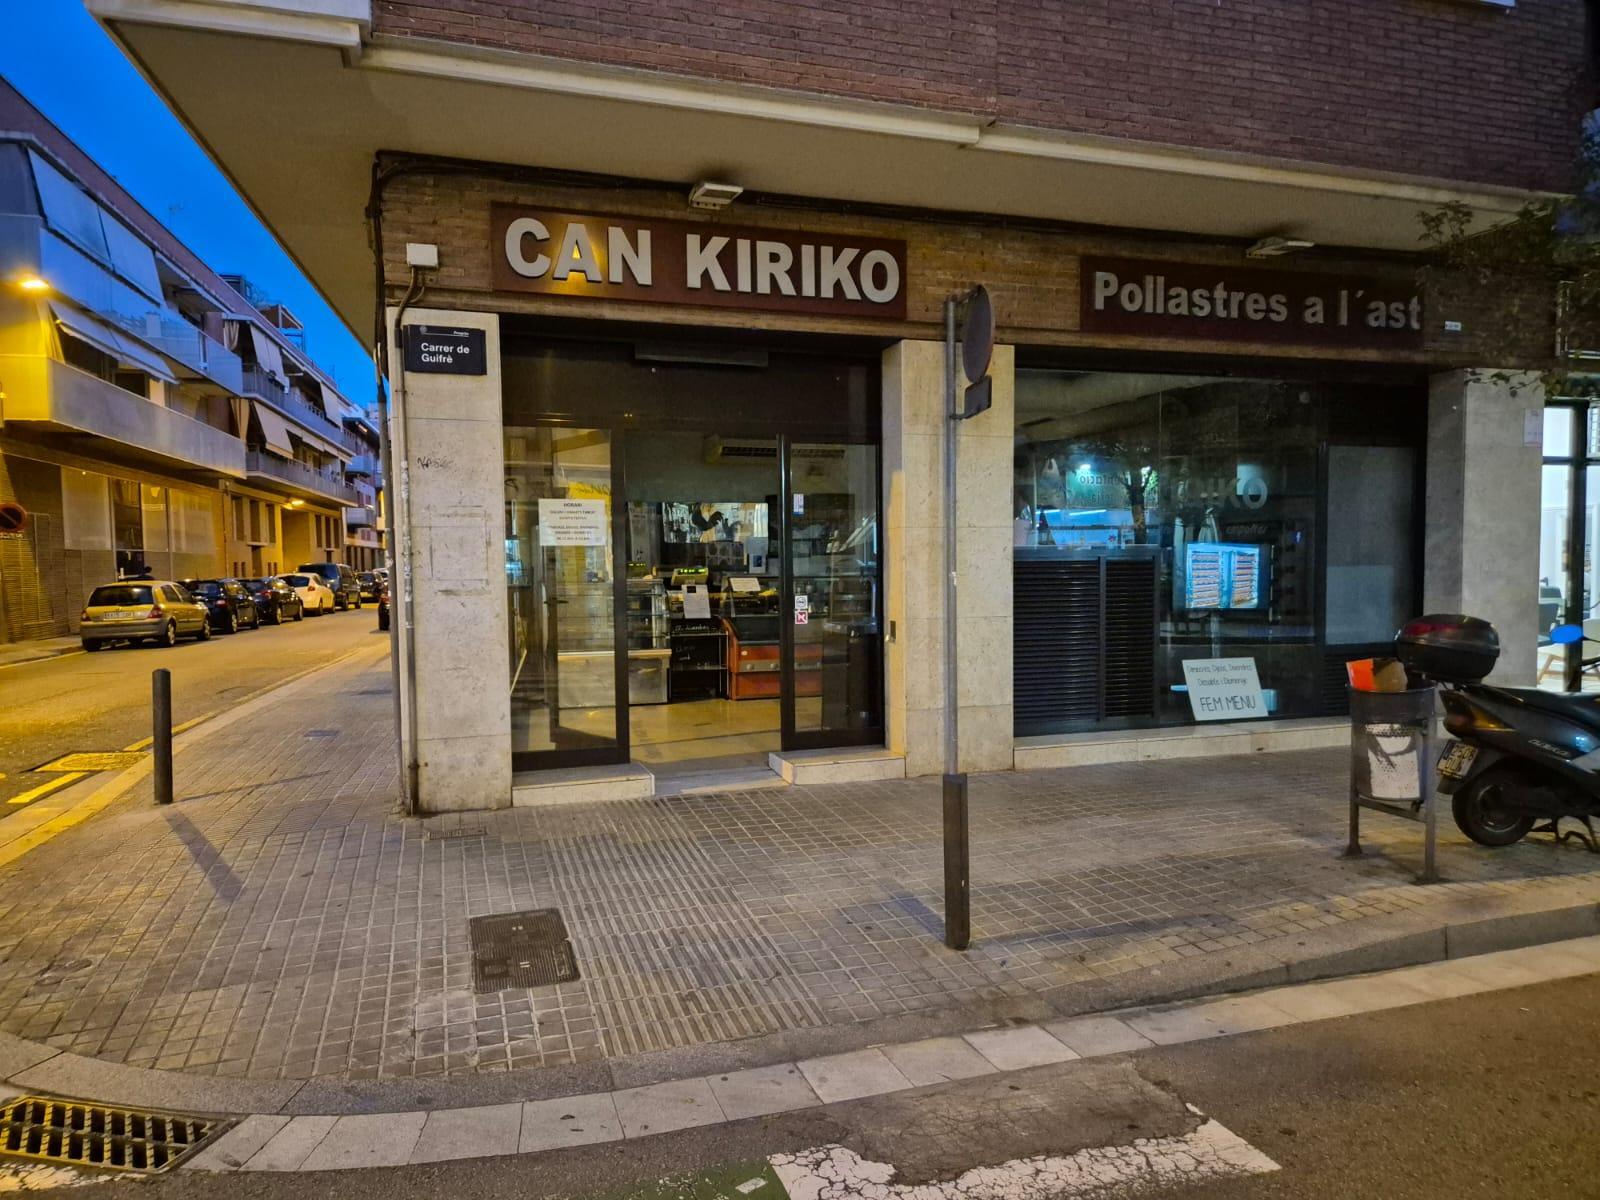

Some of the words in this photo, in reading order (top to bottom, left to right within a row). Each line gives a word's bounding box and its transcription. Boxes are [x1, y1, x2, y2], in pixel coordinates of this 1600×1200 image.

[504, 217, 653, 287] CAN
[685, 233, 901, 304] KIRIKO
[1093, 271, 1288, 323] Pollastres
[1304, 295, 1325, 325] a
[421, 342, 454, 353] Carrer
[456, 344, 470, 354] de
[421, 353, 453, 364] Guifrè
[1199, 696, 1224, 712] FEM
[1225, 695, 1256, 712] MENU
